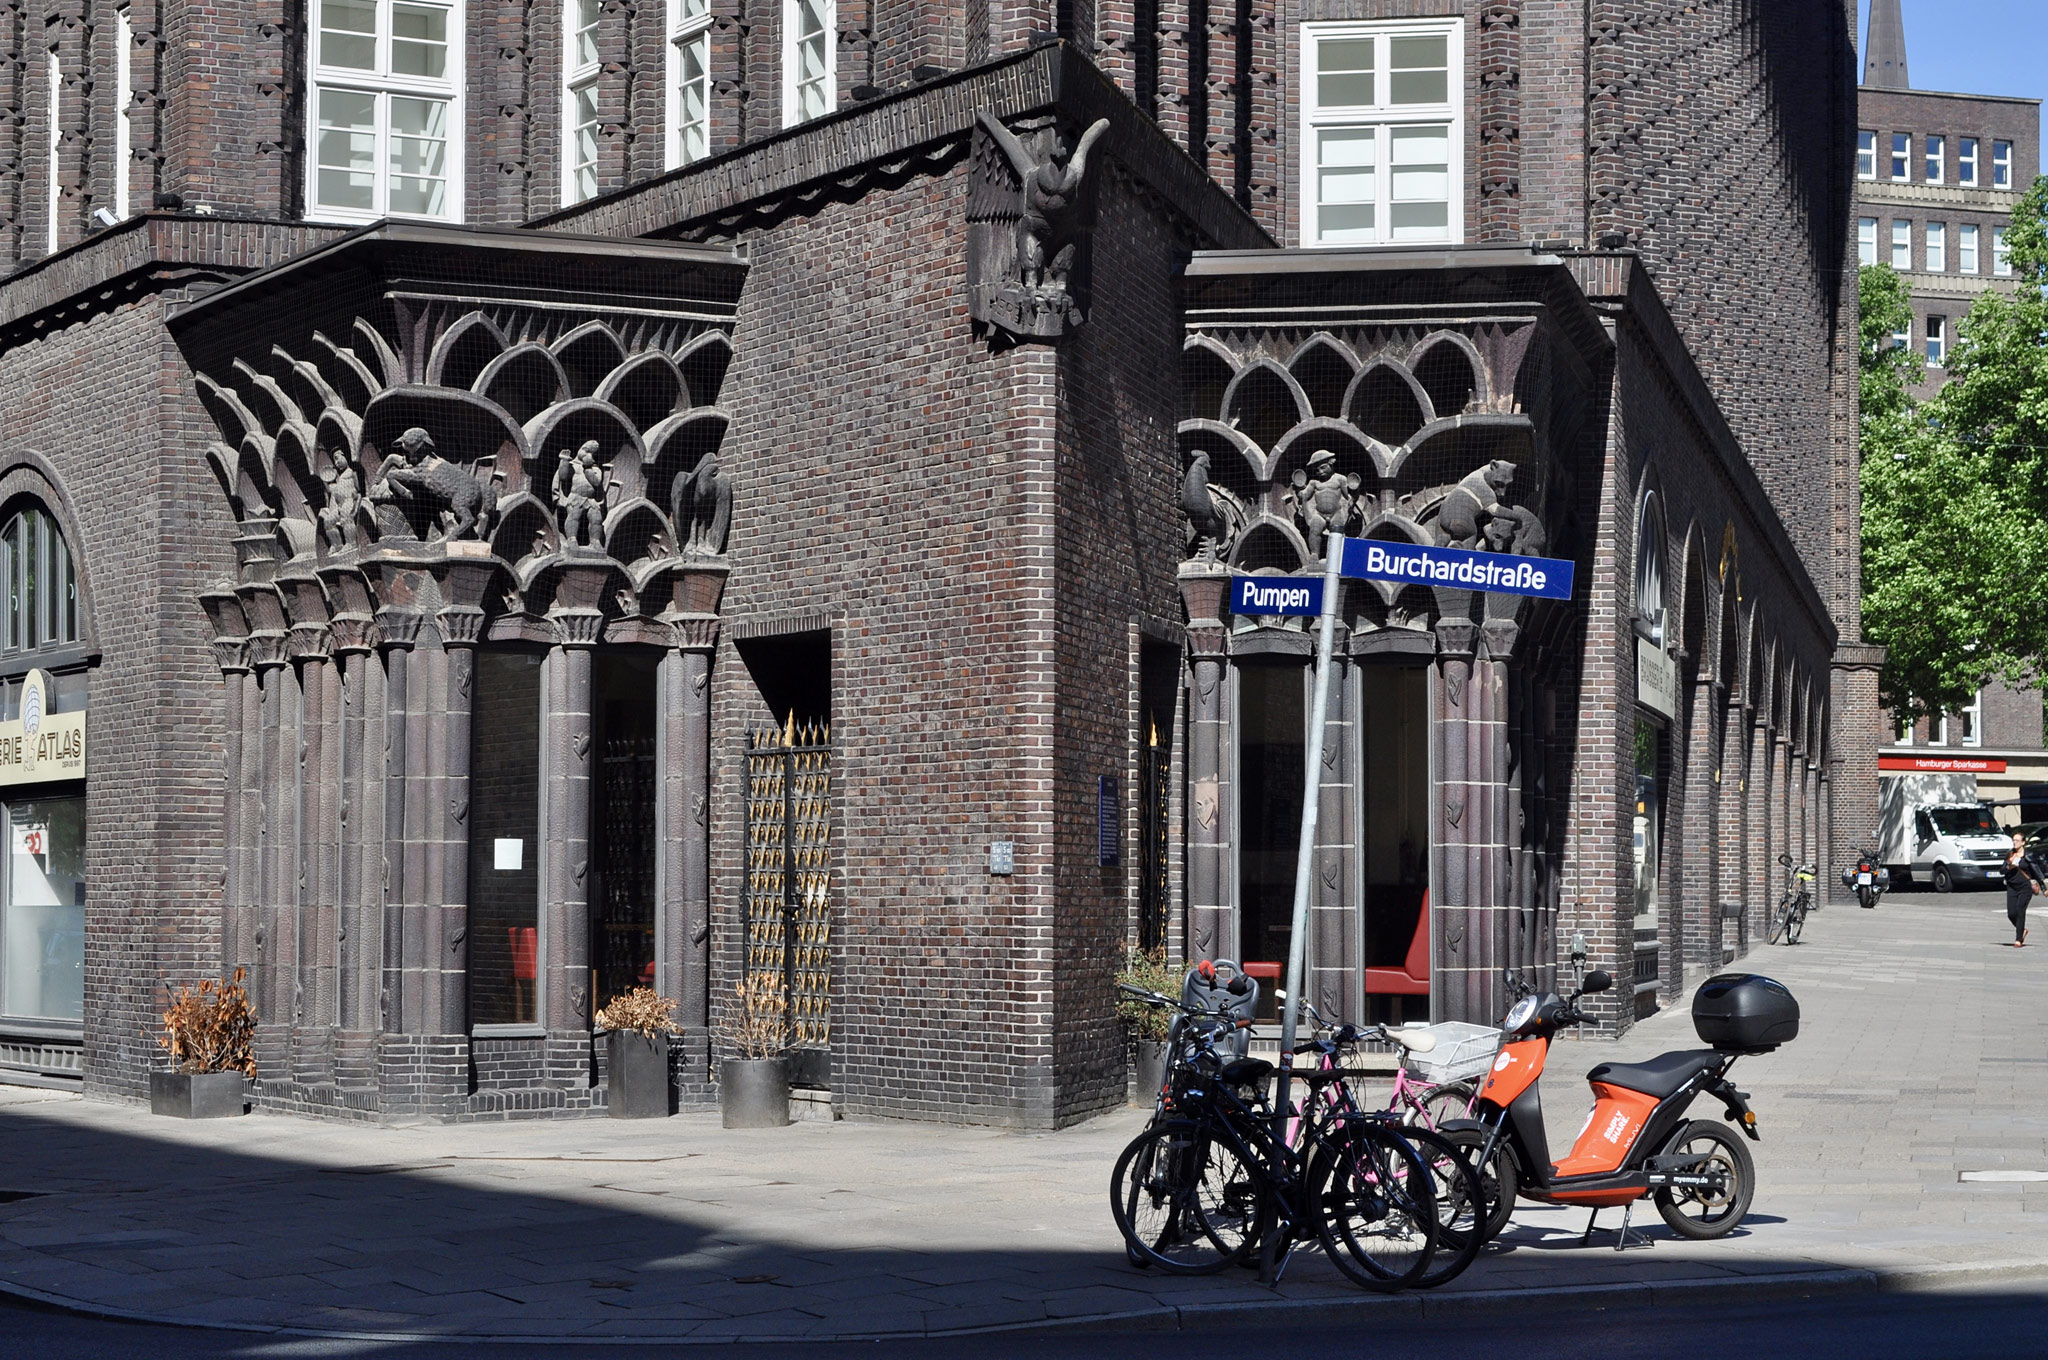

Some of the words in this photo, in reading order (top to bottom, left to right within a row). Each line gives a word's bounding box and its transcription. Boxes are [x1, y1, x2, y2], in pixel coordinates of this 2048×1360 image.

[1366, 546, 1547, 591] Burchardstraße
[1242, 581, 1310, 613] Pumpen
[37, 728, 82, 761] ATLAS
[1916, 759, 1952, 770] Hamburger
[1953, 760, 1987, 770] Sparkasse
[1604, 1110, 1624, 1139] SIMPLY
[1673, 1176, 1709, 1185] myemmy.de
